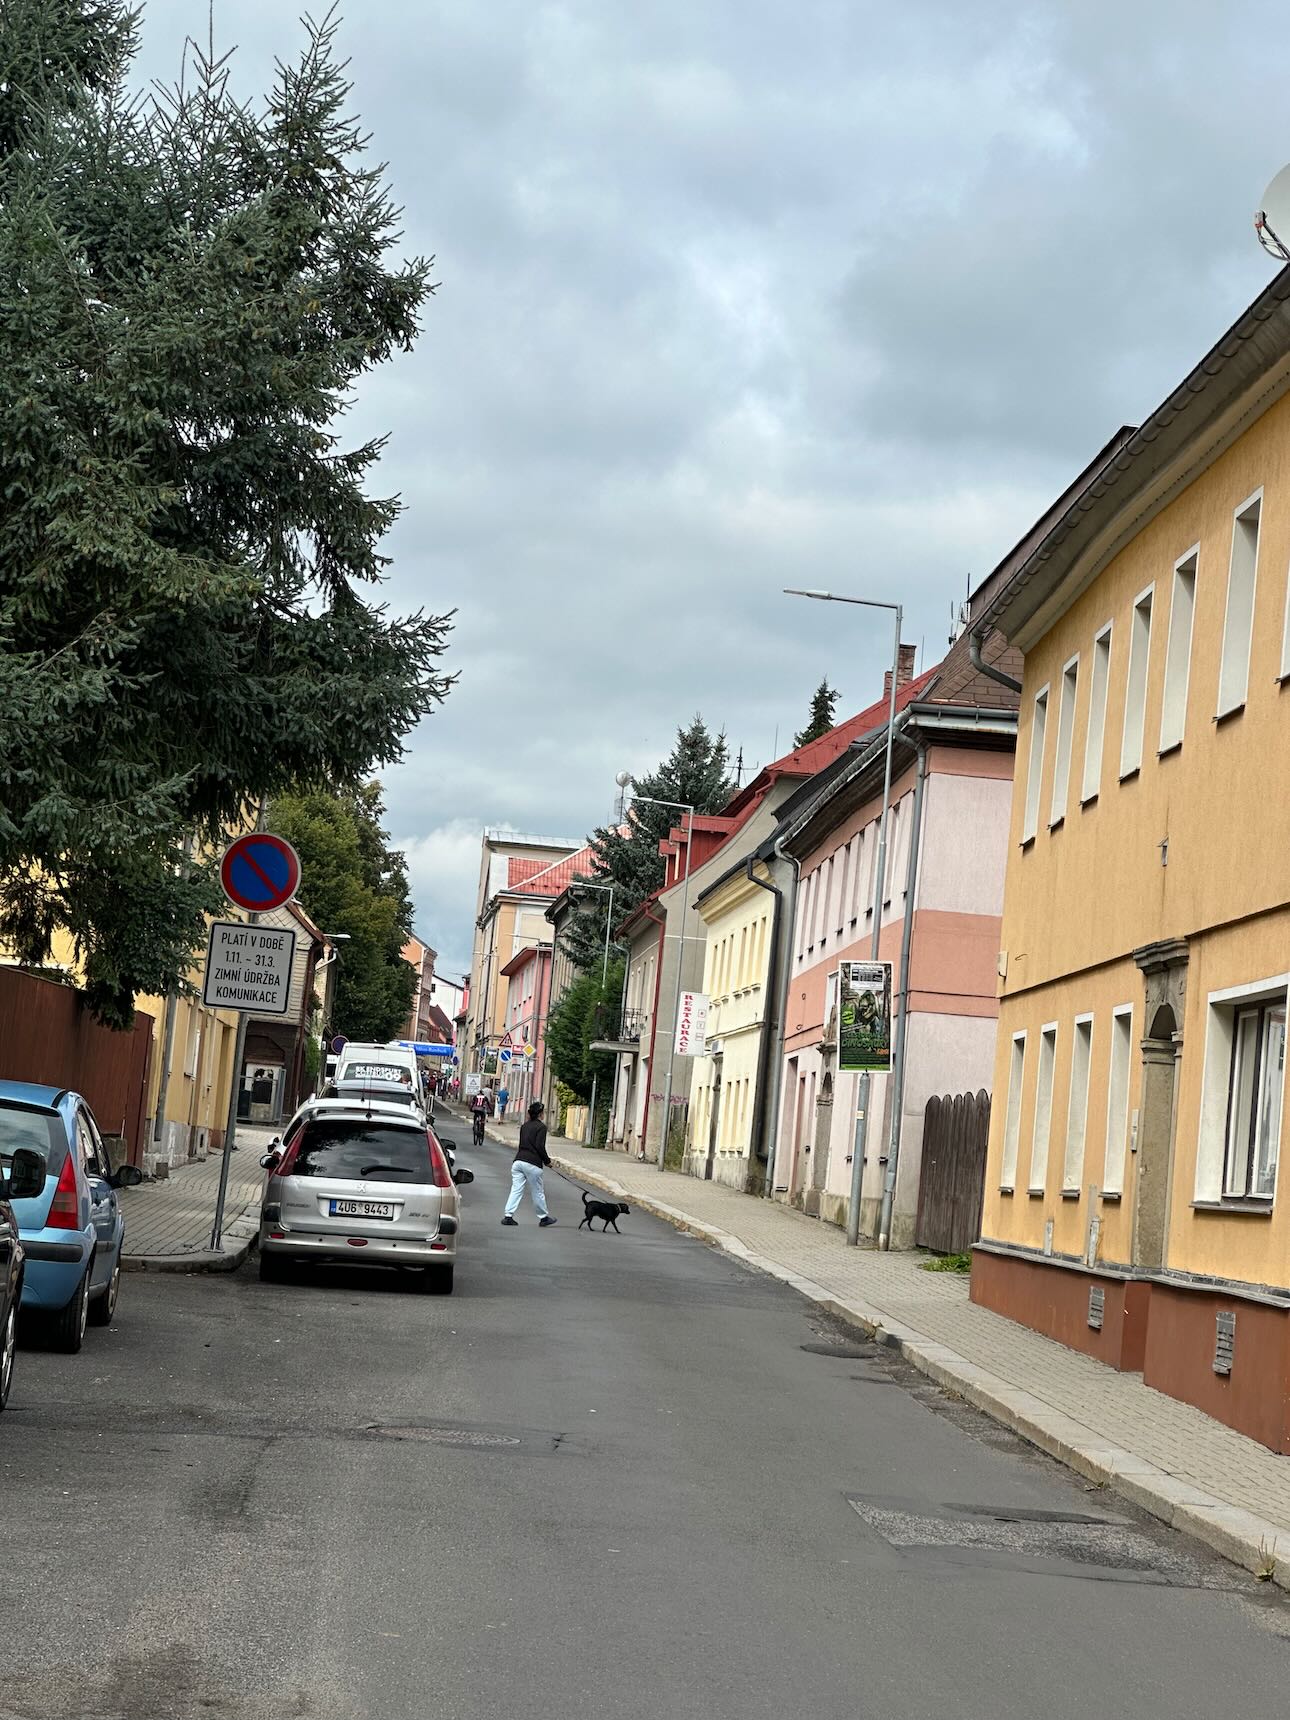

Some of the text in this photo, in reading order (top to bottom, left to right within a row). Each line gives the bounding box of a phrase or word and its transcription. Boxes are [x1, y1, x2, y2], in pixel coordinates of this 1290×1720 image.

[221, 932, 284, 951] PLATÍ V DOBĚ
[225, 951, 242, 964] 1.11.
[254, 954, 275, 968] 31.3.
[214, 967, 281, 986] ZIMNÍ ÚDRŽBA
[215, 986, 278, 1003] KOMUNIKACE
[678, 994, 694, 1053] RESTAURACE
[385, 1073, 401, 1081] 09
[338, 1201, 389, 1215] 4U6 9443
